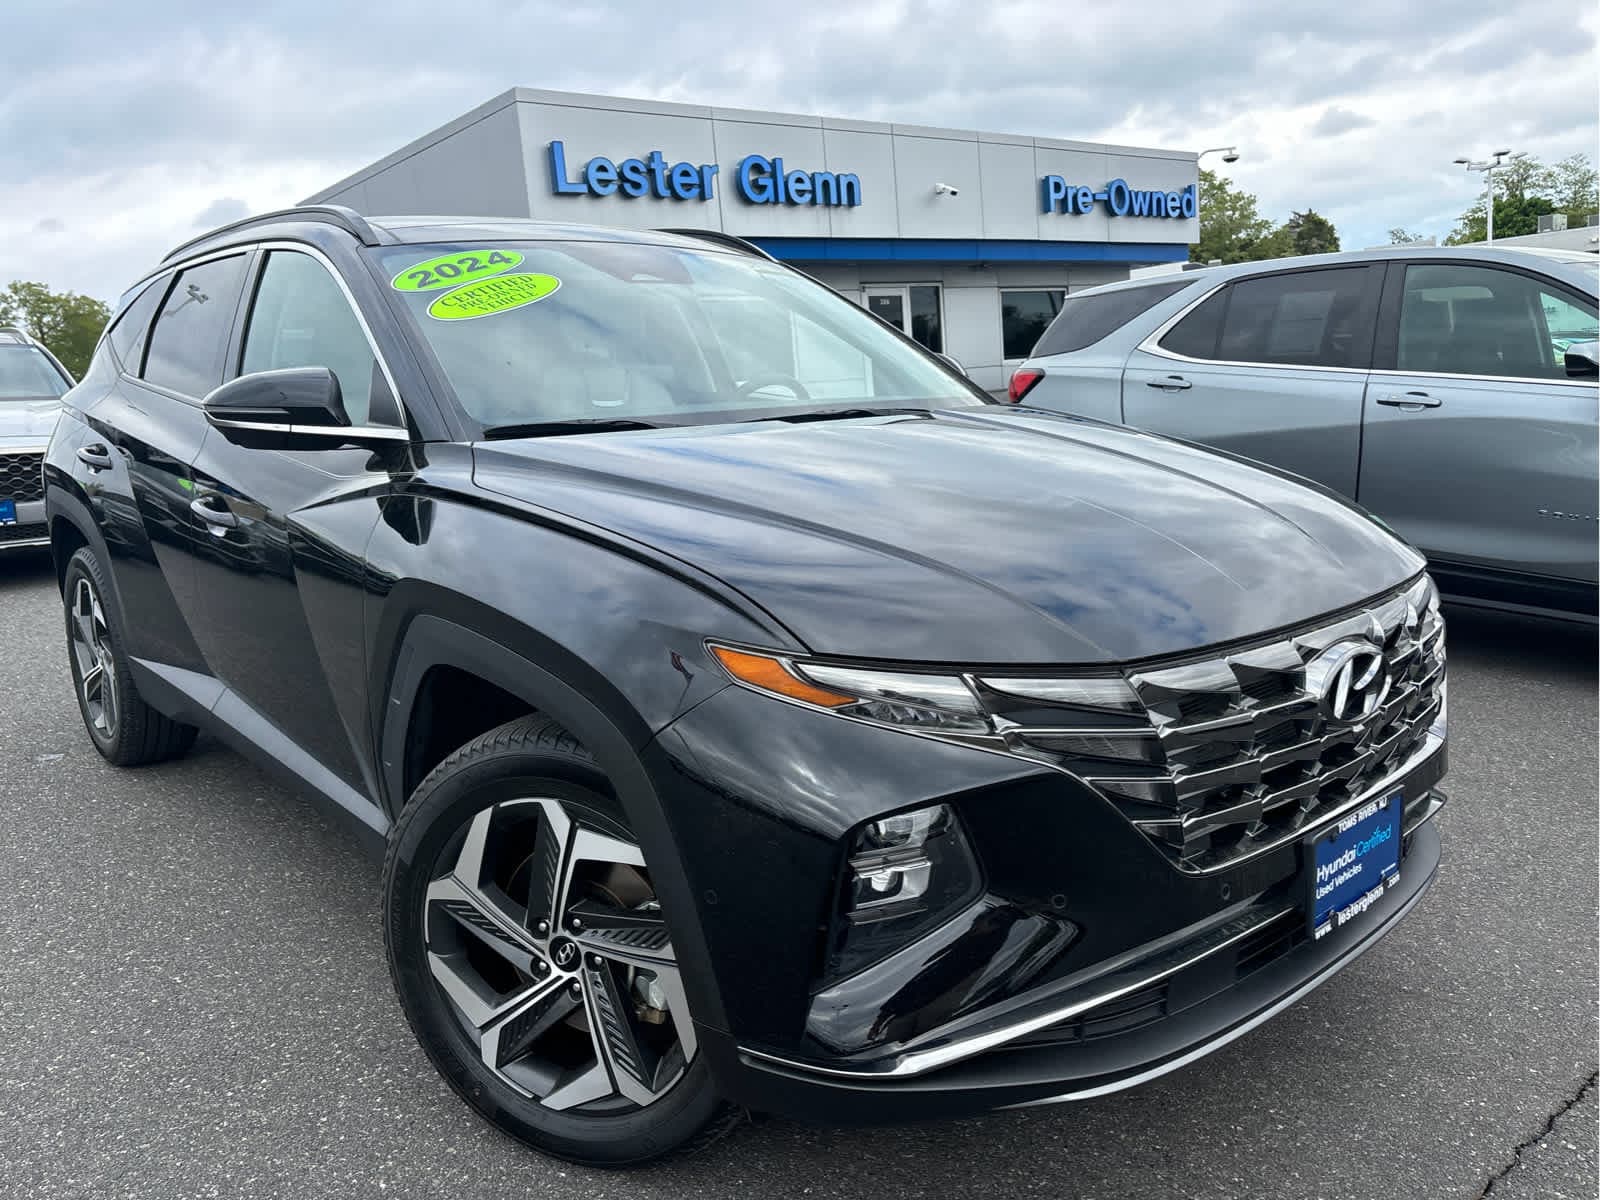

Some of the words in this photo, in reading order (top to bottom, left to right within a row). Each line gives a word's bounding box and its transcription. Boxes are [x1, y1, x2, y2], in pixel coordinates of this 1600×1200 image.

[547, 140, 719, 200] Lester
[738, 154, 862, 207] Glenn
[1042, 175, 1197, 218] Pre-Owned
[408, 251, 513, 288] 2024
[441, 275, 533, 307] CERTIFIED
[478, 291, 539, 312] VEHICLE
[1338, 815, 1357, 833] TOMS
[1316, 845, 1356, 883] Hyundai
[1356, 824, 1392, 857] Certified
[1315, 877, 1334, 899] Used
[1334, 863, 1362, 886] Vehicles
